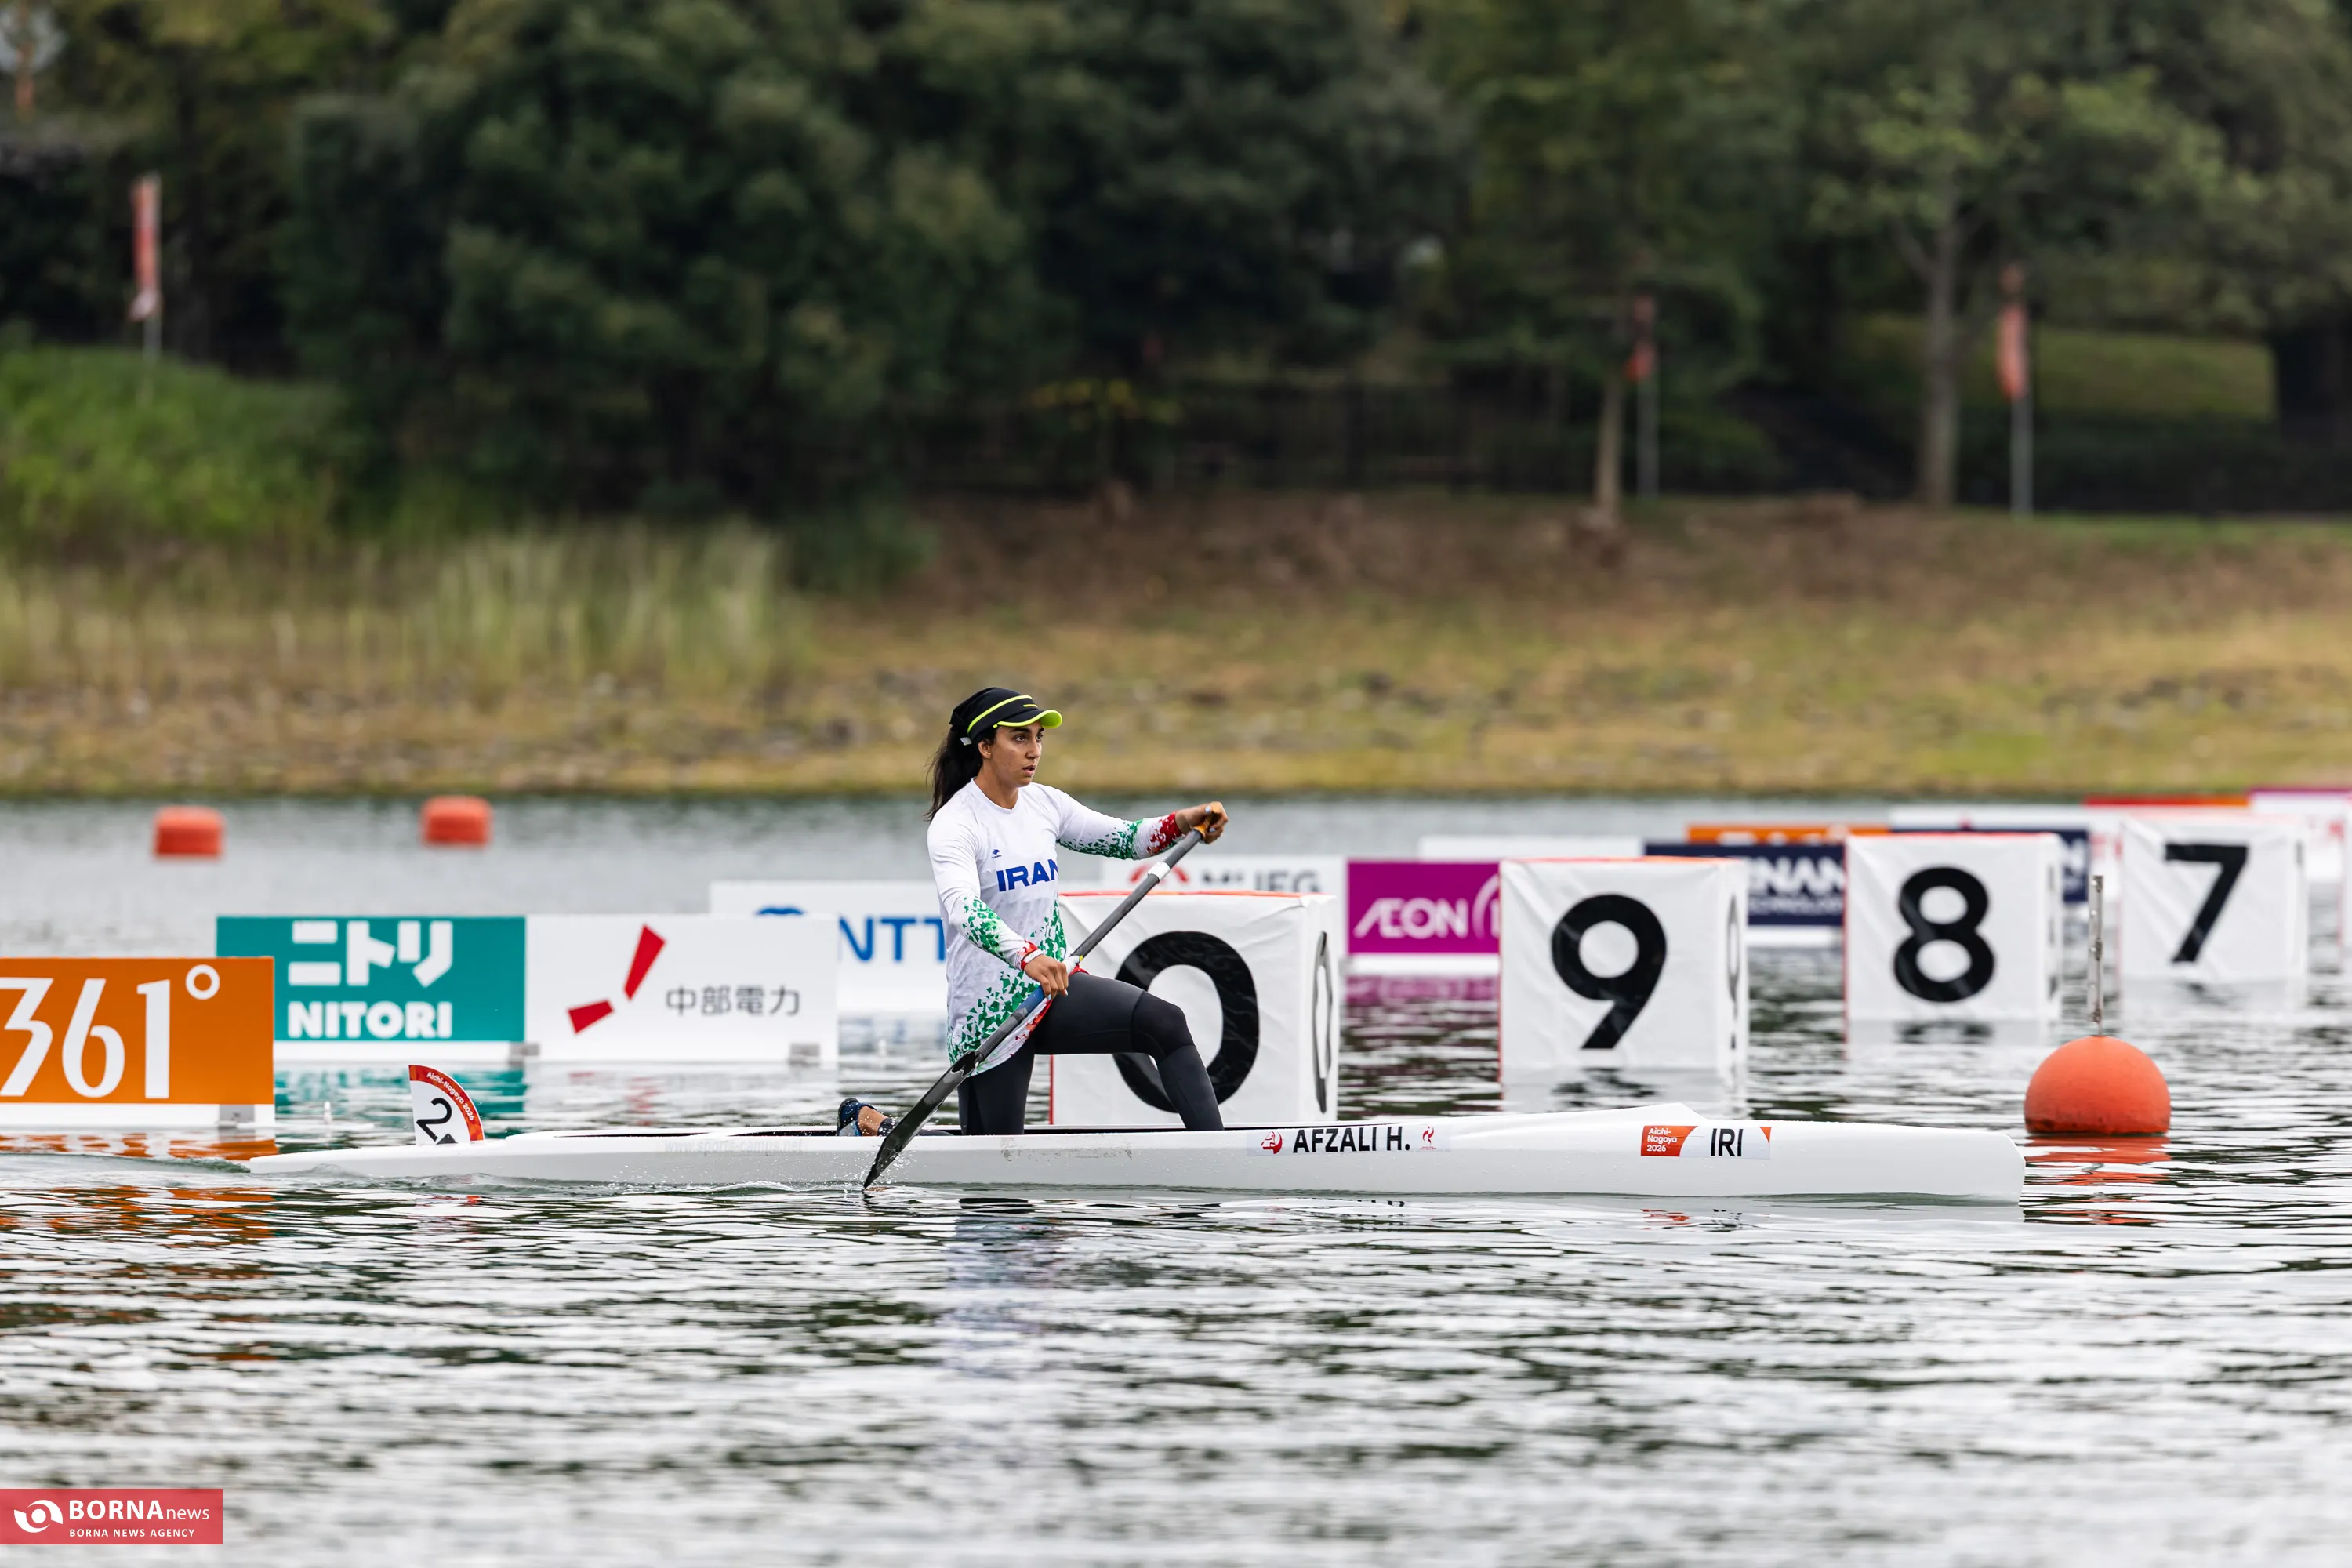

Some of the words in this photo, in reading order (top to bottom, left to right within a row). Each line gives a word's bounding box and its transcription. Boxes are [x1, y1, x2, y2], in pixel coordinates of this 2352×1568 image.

[996, 859, 1058, 892] IRAN
[2164, 843, 2249, 962] 7
[288, 920, 453, 988] ニトリ
[839, 916, 946, 962] NTT
[1893, 867, 1994, 1003] 8
[1551, 893, 1667, 1049] 9
[288, 1000, 452, 1039] NITORI
[666, 985, 800, 1017] 中部電力
[1112, 931, 1260, 1113] 0
[416, 1098, 452, 1142] 2
[463, 1103, 474, 1121] 2026
[1293, 1127, 1377, 1153] AFZALI
[1387, 1126, 1410, 1151] H.
[1647, 1135, 1677, 1144] Nagoya
[1711, 1128, 1743, 1156] IRI
